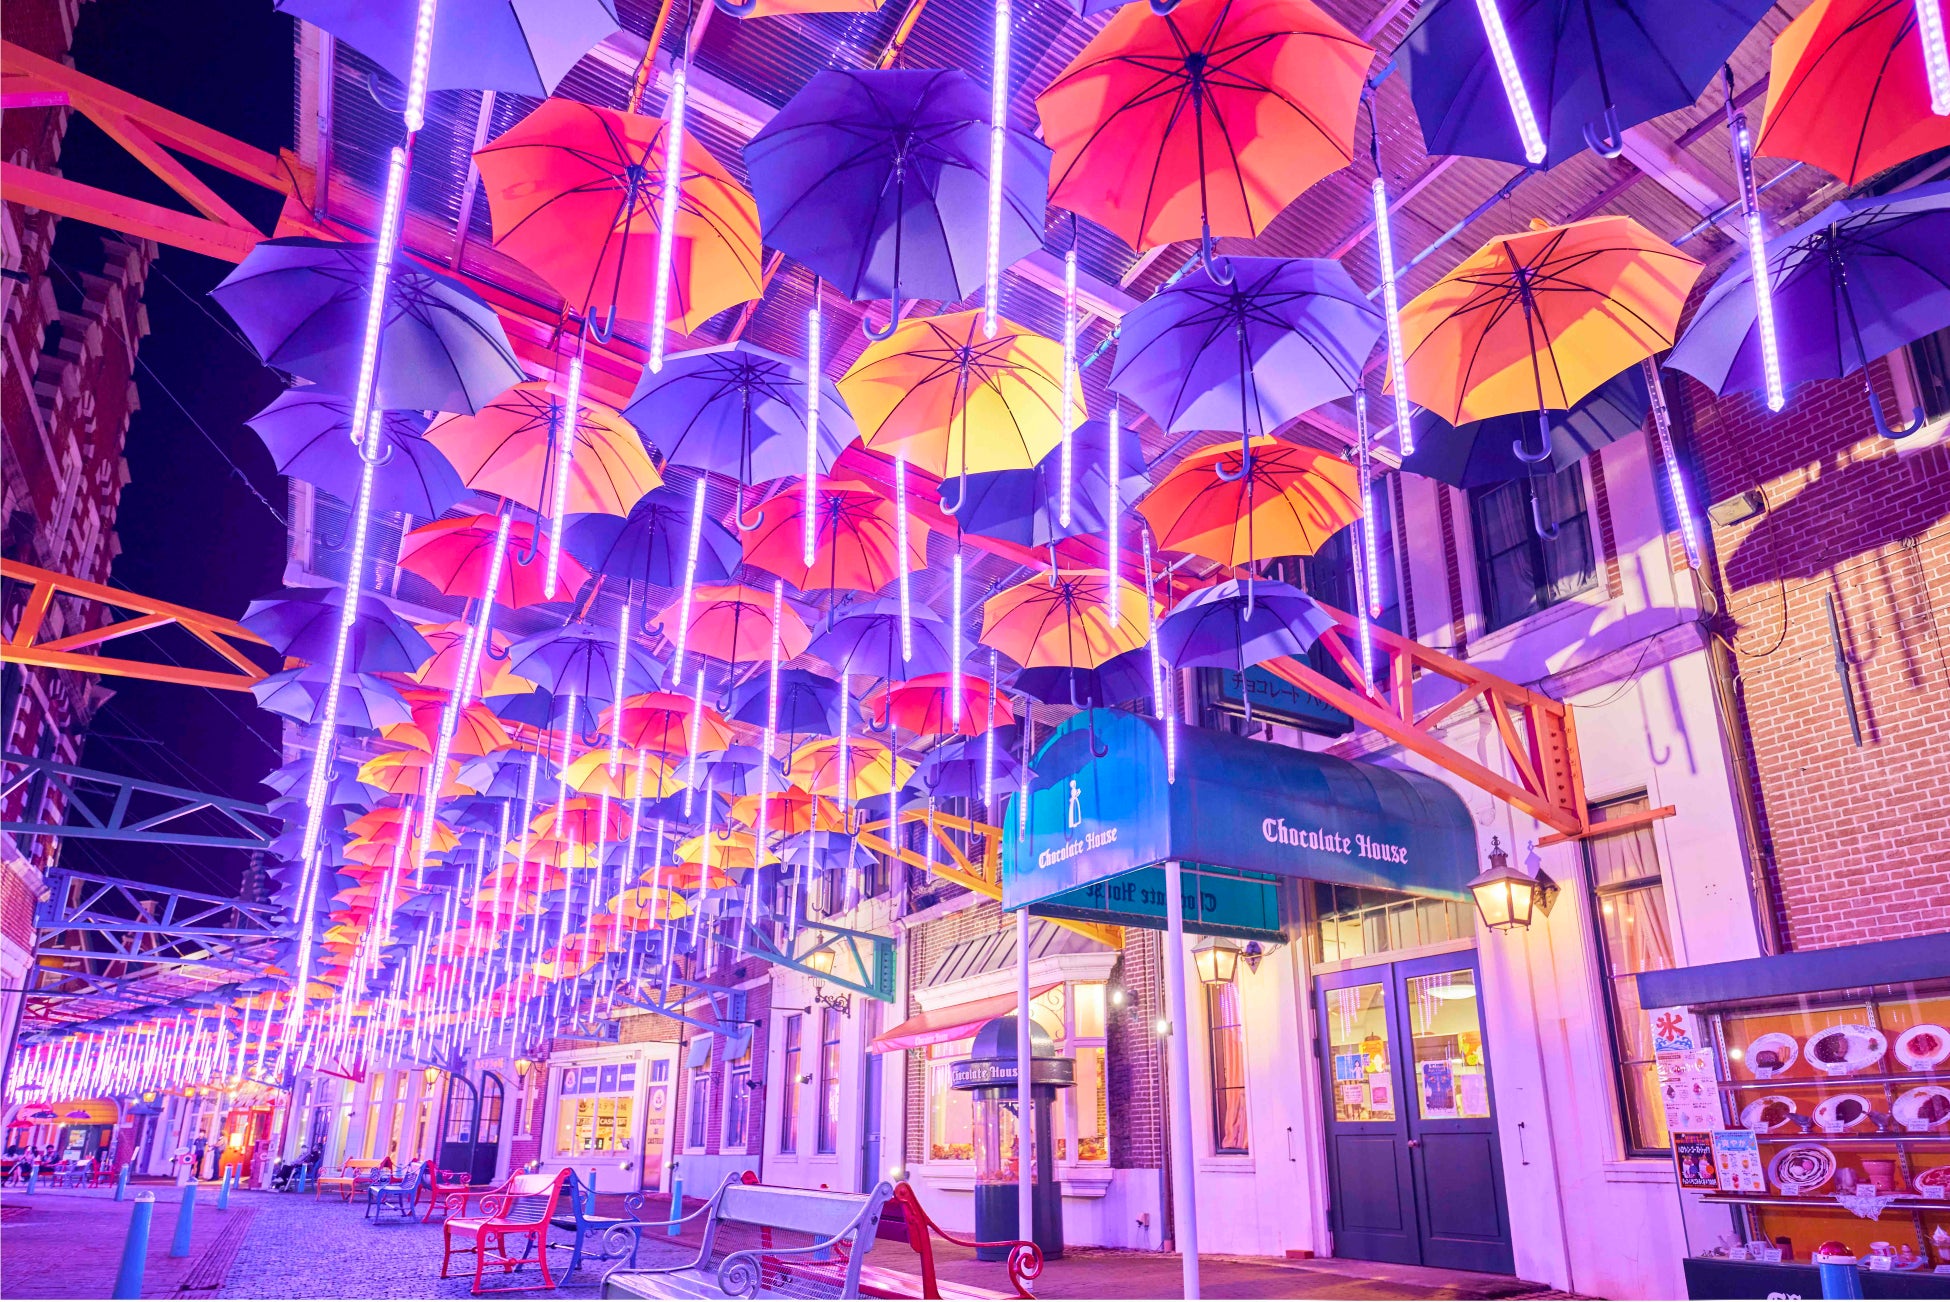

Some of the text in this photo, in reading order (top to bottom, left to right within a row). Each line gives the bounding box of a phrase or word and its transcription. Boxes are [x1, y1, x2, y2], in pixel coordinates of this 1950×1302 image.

[1232, 673, 1300, 705] チョコレート
[1038, 826, 1118, 869] Chocolate House
[1262, 817, 1409, 865] Chocolate House
[1656, 1012, 1686, 1042] 氷
[952, 1066, 1018, 1082] Chocolate Hous
